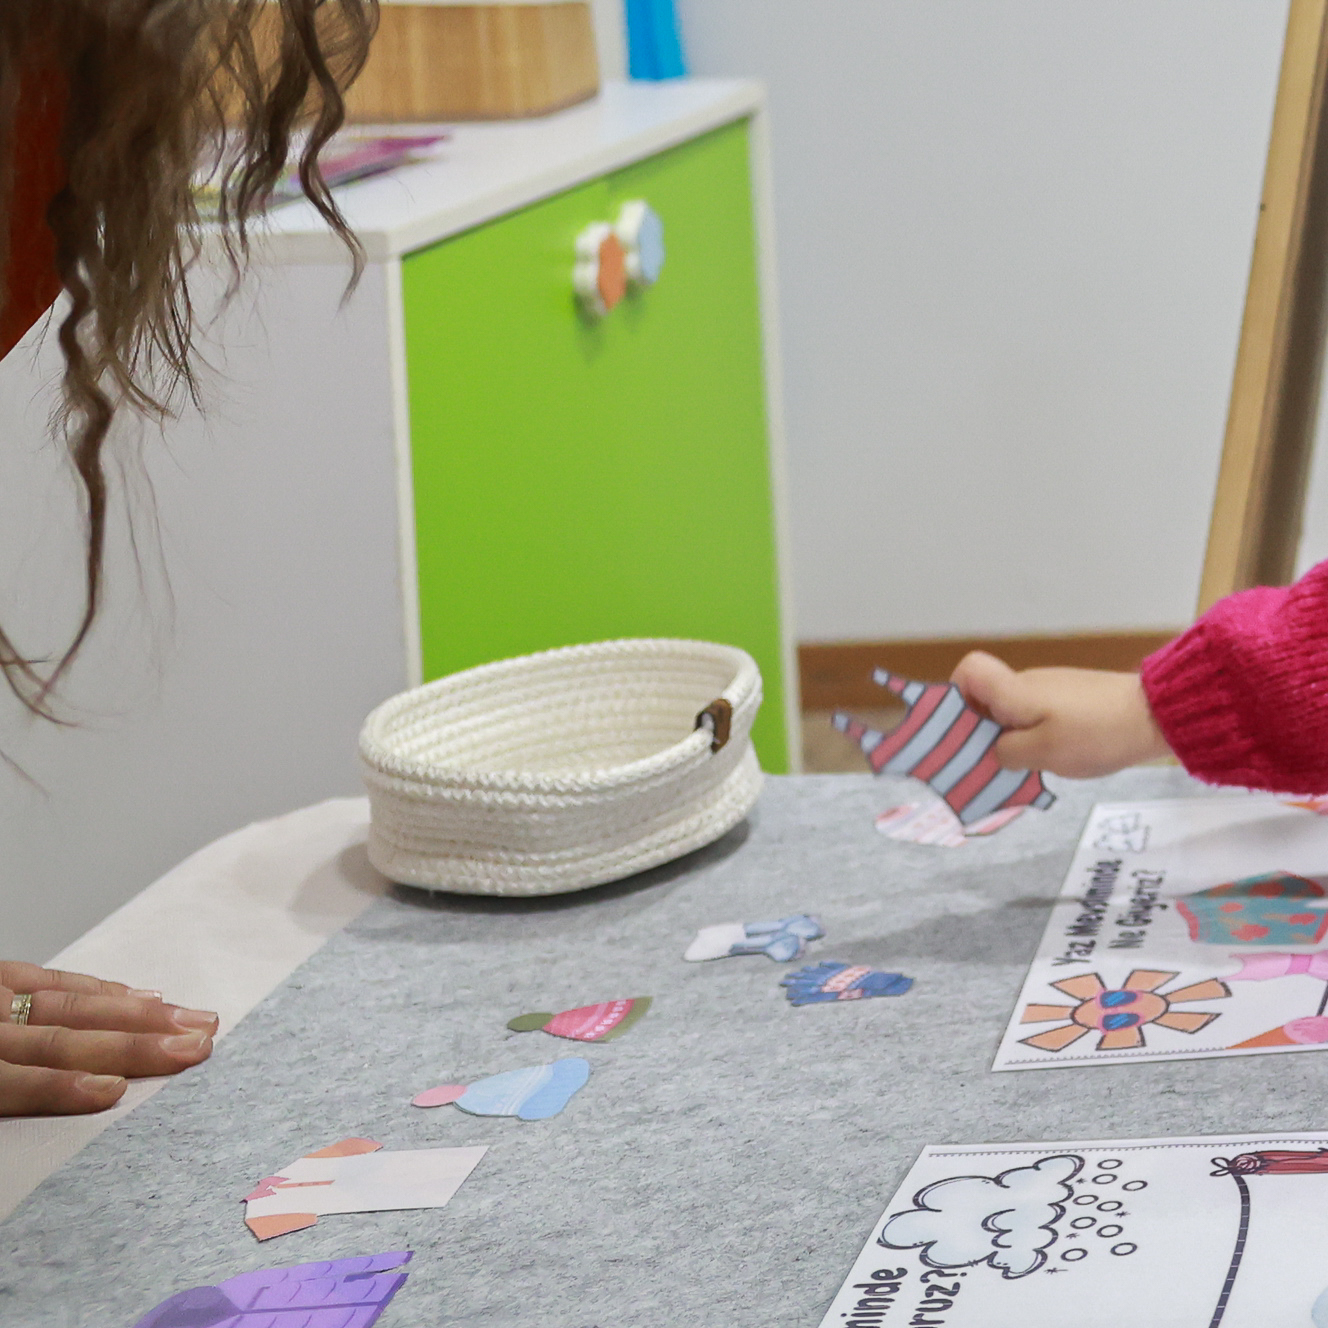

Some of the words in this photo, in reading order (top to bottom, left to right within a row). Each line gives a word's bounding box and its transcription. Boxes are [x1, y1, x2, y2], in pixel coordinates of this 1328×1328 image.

[1051, 939, 1096, 966] Yaz
[1107, 929, 1146, 949] Ne
[909, 1269, 967, 1328] ruz?
